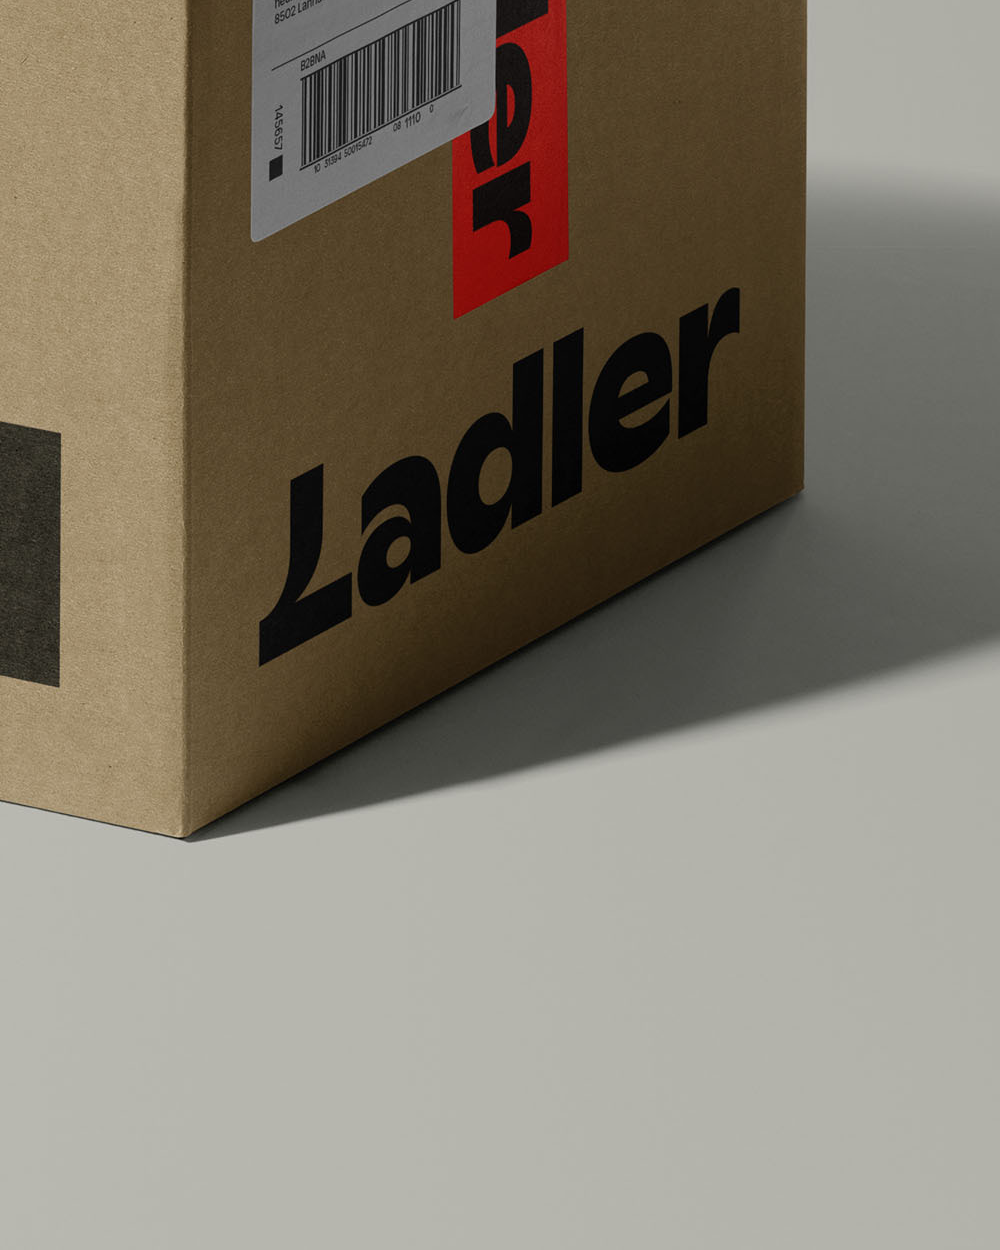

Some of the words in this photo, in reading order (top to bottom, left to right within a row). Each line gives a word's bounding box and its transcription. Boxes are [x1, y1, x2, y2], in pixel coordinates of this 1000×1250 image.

[274, 5, 296, 25] 8502
[274, 104, 284, 151] 145657
[314, 162, 321, 174] 10
[324, 152, 342, 168] 31394
[393, 120, 402, 132] 08
[404, 111, 421, 128] 1110
[258, 286, 741, 668] Ladler
